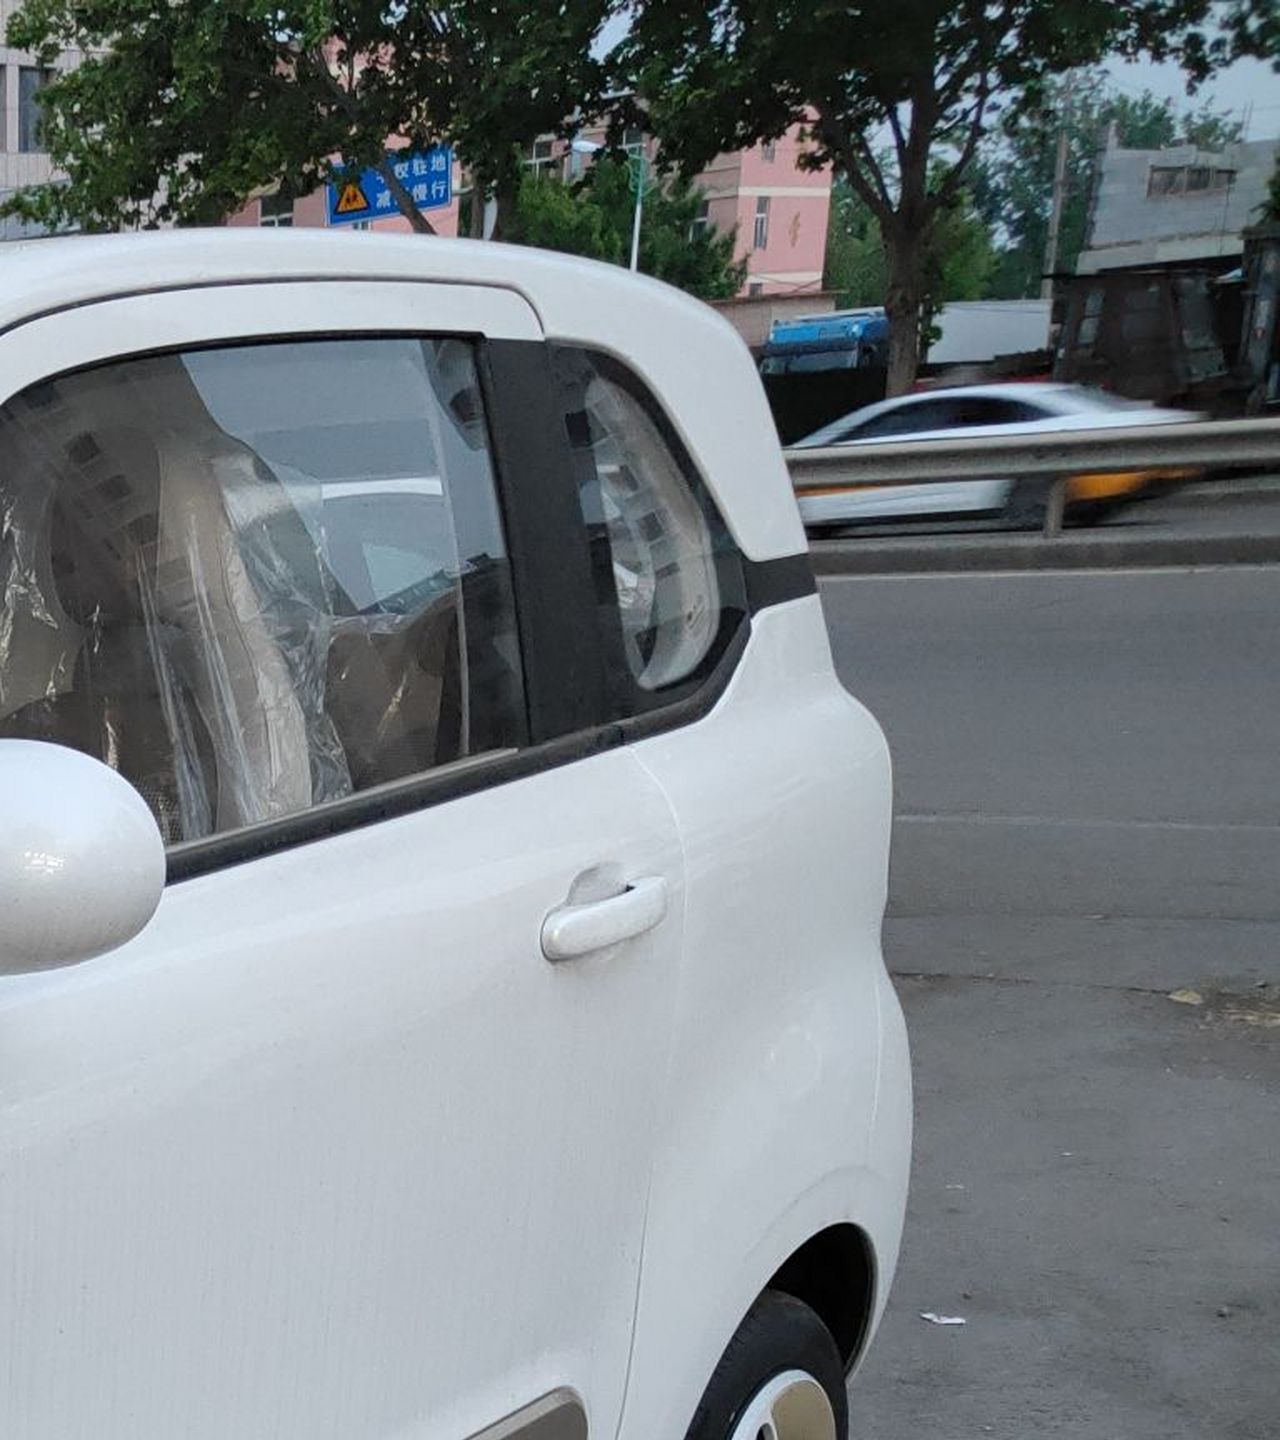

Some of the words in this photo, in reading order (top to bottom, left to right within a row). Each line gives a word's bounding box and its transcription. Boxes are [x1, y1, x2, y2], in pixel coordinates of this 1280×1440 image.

[376, 154, 446, 187] 校驻地
[376, 180, 447, 209] 减慢行
